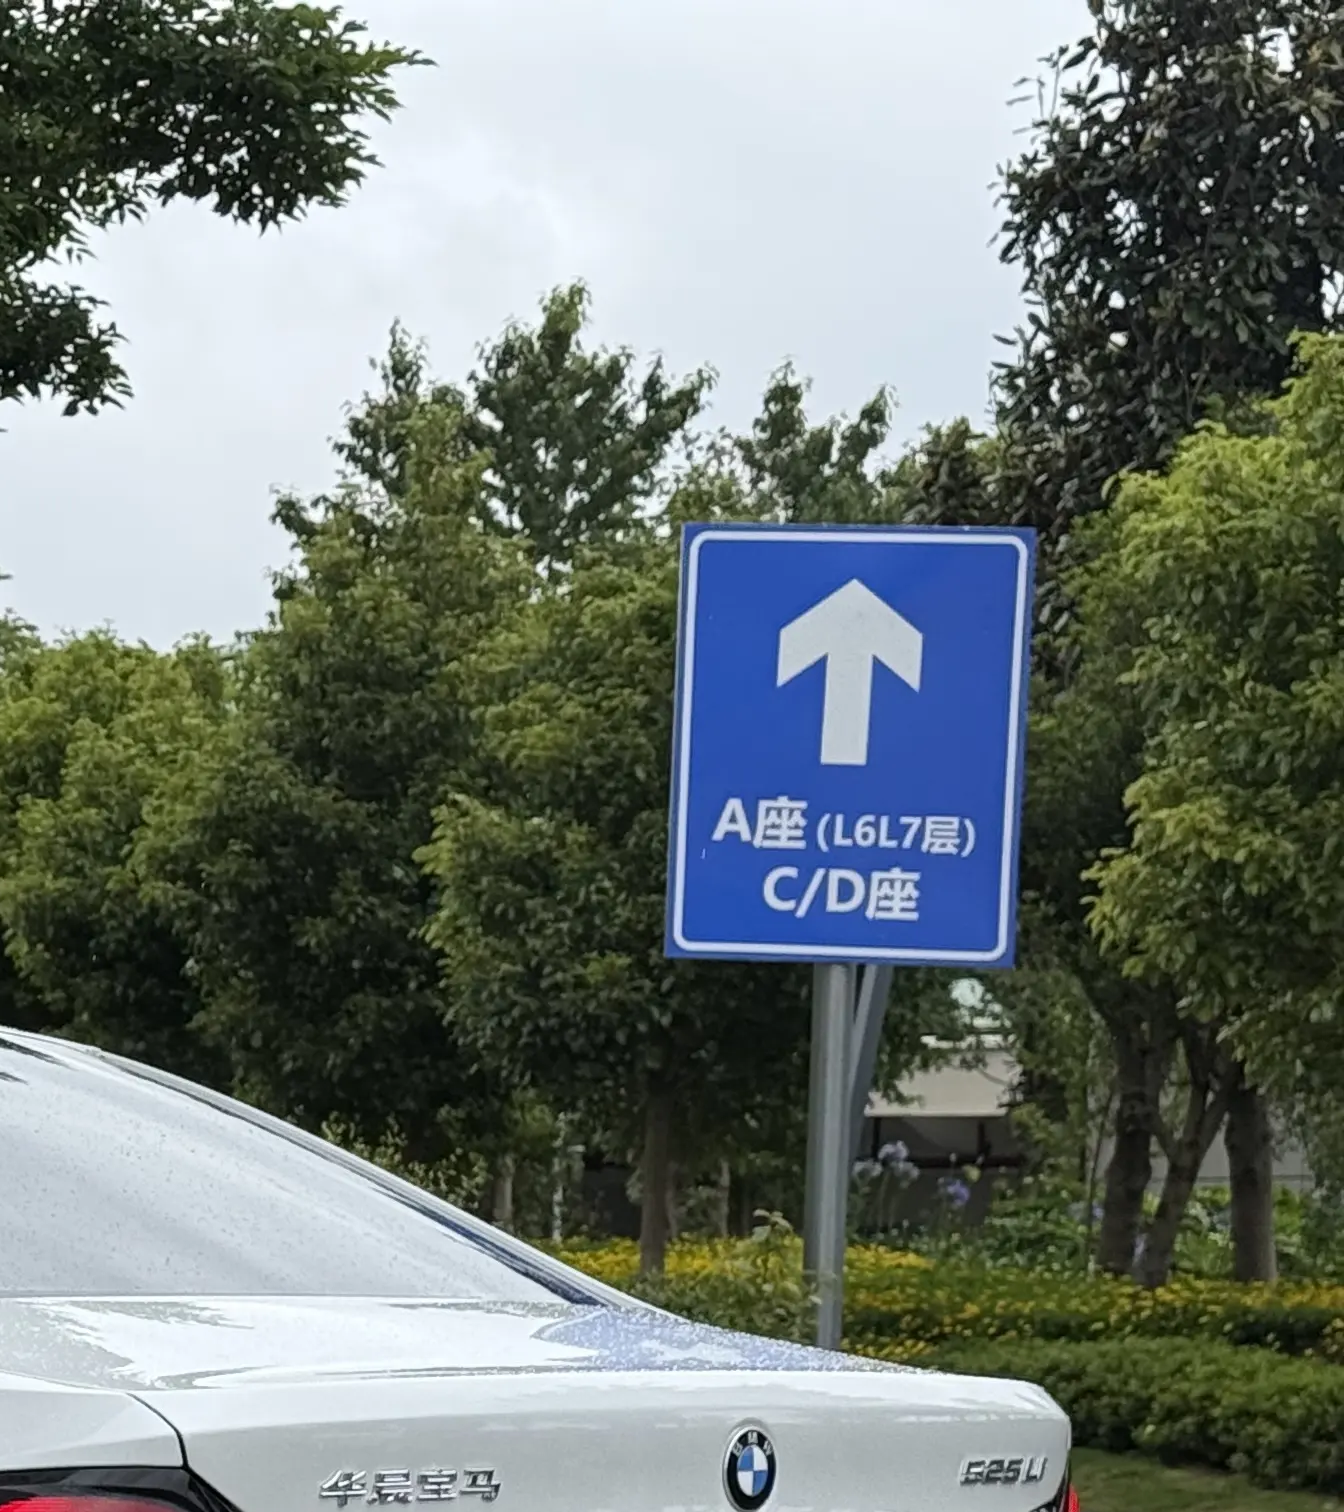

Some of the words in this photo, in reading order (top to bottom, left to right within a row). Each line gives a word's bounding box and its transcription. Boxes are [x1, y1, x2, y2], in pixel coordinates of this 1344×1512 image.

[712, 796, 808, 849] A座
[816, 812, 976, 857] (L6L7层)
[762, 866, 922, 922] C/D座
[319, 1466, 501, 1508] 华晨宝马
